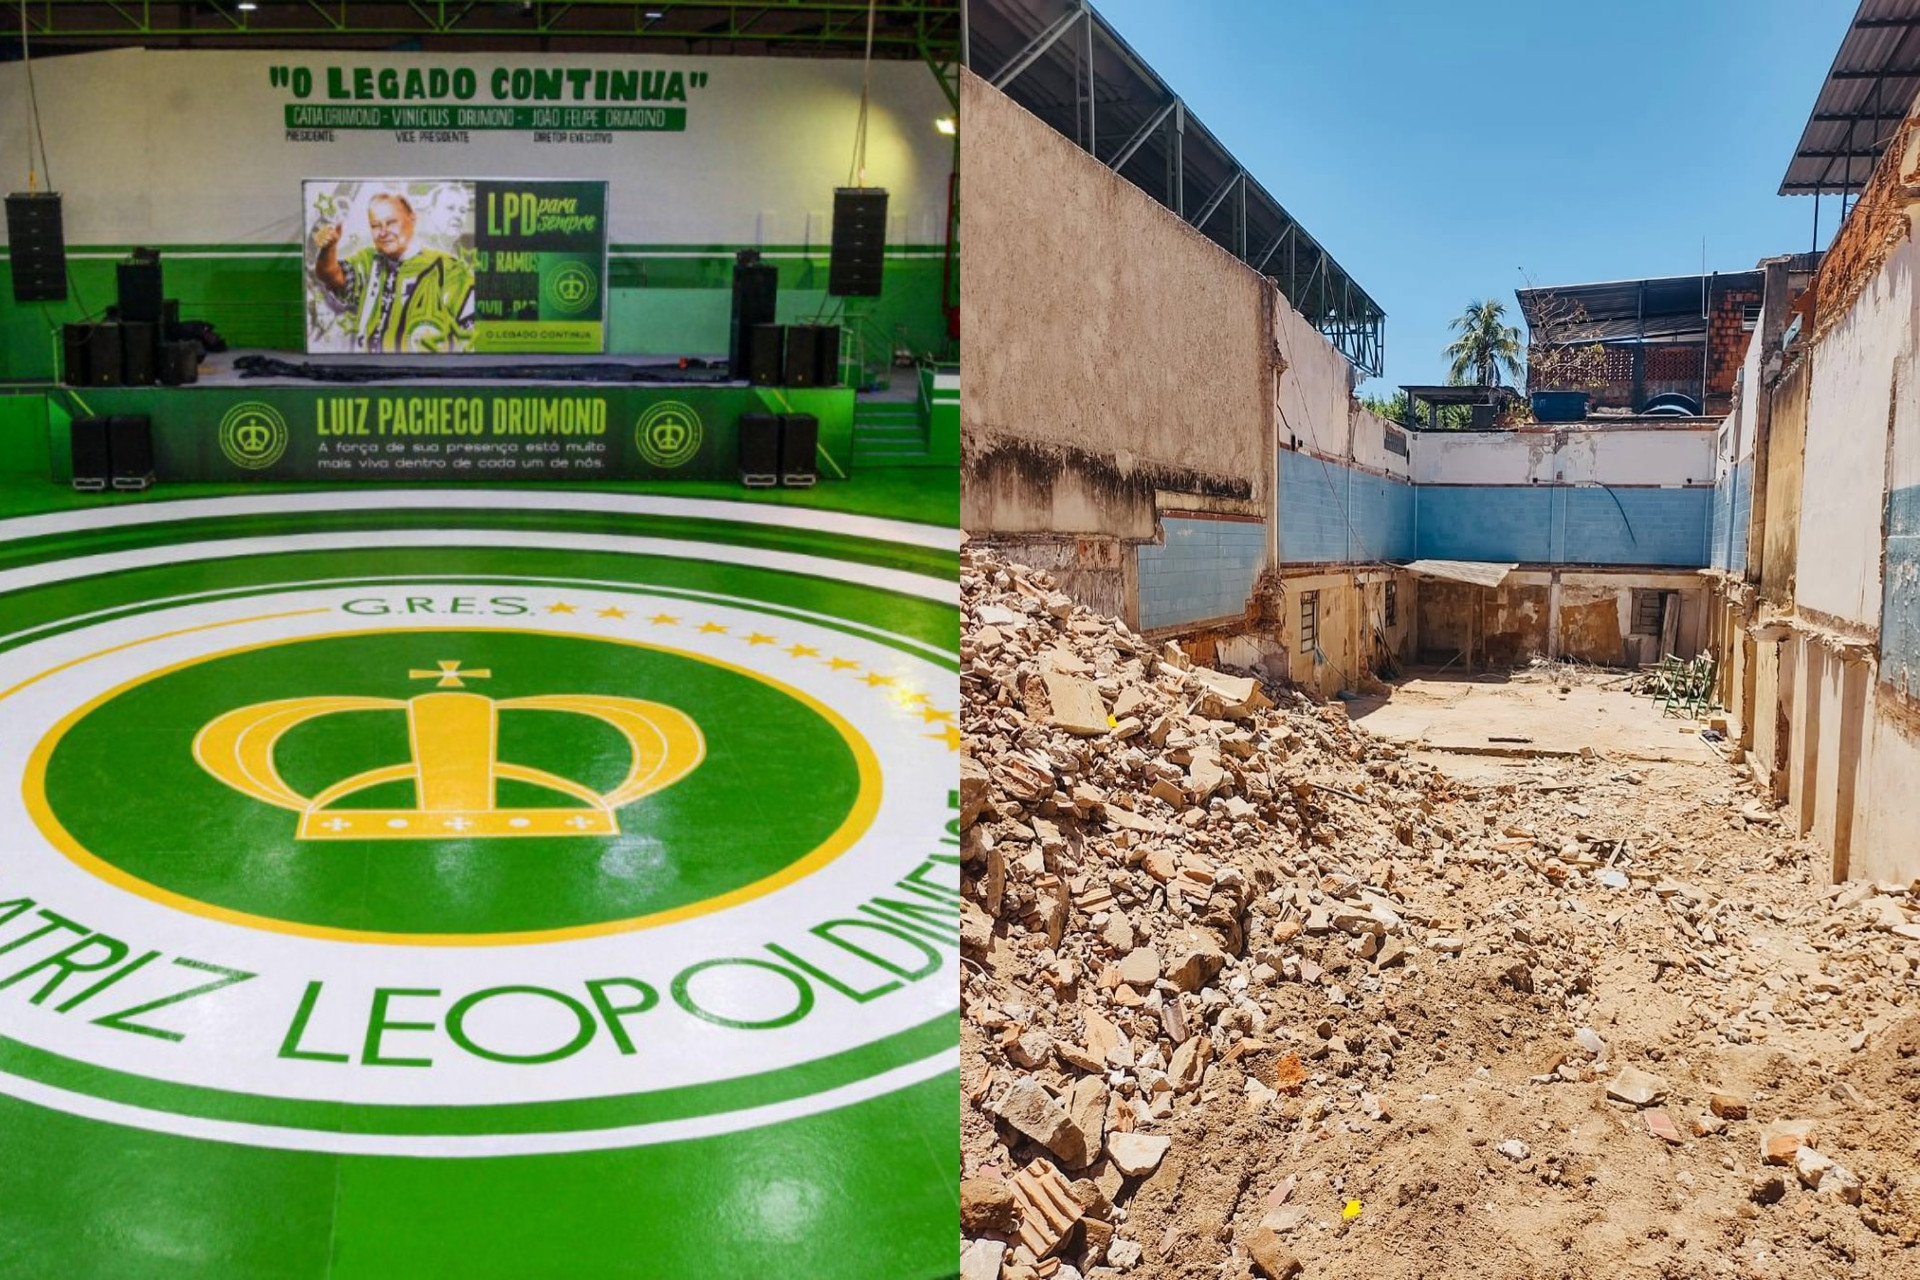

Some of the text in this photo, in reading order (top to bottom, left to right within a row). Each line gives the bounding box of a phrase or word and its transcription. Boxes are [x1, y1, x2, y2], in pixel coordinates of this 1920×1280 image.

[327, 67, 476, 100] LEGADO
[491, 67, 708, 101] CONTINUA"
[324, 107, 381, 126] DRUMOND
[457, 108, 514, 127] DRUMOND
[564, 108, 598, 127] FELIPE
[605, 108, 665, 127] DRUMOND
[285, 129, 335, 142] PRESIDENTE
[395, 130, 470, 143] VICE PRESIDENTE
[533, 131, 613, 144] DIRETOR EXECUTIVO
[487, 192, 537, 236] LPD
[537, 197, 577, 216] para
[538, 214, 597, 235] sempre
[496, 330, 538, 339] LEGADO
[540, 330, 592, 339] CONTINUA
[317, 397, 371, 436] LUIZ
[378, 397, 484, 436] PACHECO
[492, 397, 606, 436] DRUMOND
[319, 441, 329, 453] A
[336, 441, 379, 456] força
[385, 441, 405, 453] de
[412, 442, 439, 453] sua
[446, 442, 519, 455] presença
[565, 441, 606, 453] muito
[318, 457, 352, 469] mais
[358, 458, 389, 469] viva
[395, 457, 447, 469] dentro
[452, 457, 472, 469] de
[477, 457, 516, 469] cada
[521, 459, 545, 469] um
[550, 457, 569, 469] de
[341, 596, 536, 616] G.R.E.S.
[0, 789, 960, 1067] TRIZ LEOPOLDINE
